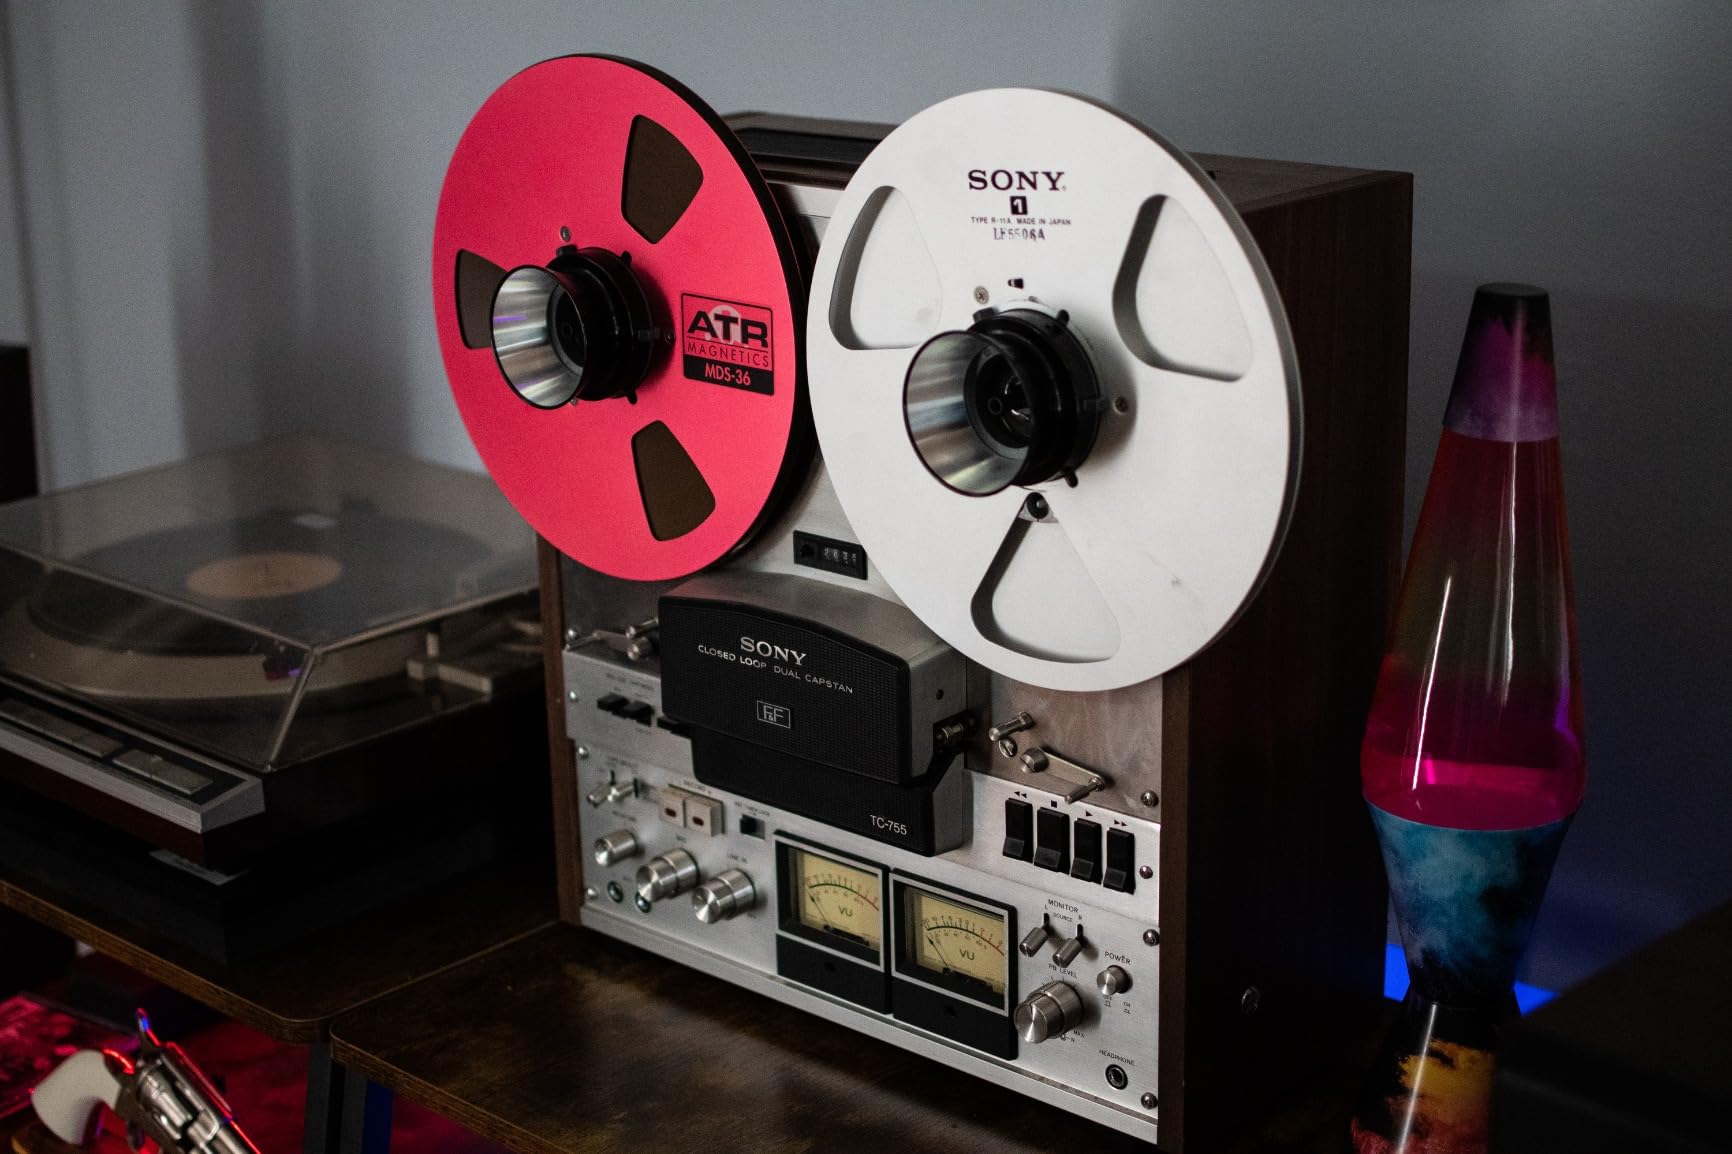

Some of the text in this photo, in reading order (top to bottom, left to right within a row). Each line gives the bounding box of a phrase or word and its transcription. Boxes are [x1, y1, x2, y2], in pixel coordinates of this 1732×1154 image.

[968, 169, 1065, 191] SONY
[971, 216, 988, 224] TYPE
[1016, 217, 1036, 225] MADE
[687, 310, 769, 348] ATR
[687, 341, 769, 368] MAGNETICS
[704, 362, 751, 386] MDS-36
[740, 636, 807, 666] SONY
[698, 644, 853, 694] CLOSED LOOP DUAL CAPSTAN
[870, 814, 908, 836] TC-755
[838, 905, 854, 918] VU
[1048, 898, 1079, 914] MONITOR
[960, 948, 975, 961] VU
[1104, 950, 1131, 966] POWER
[1098, 1048, 1136, 1067] HEADPHONE
